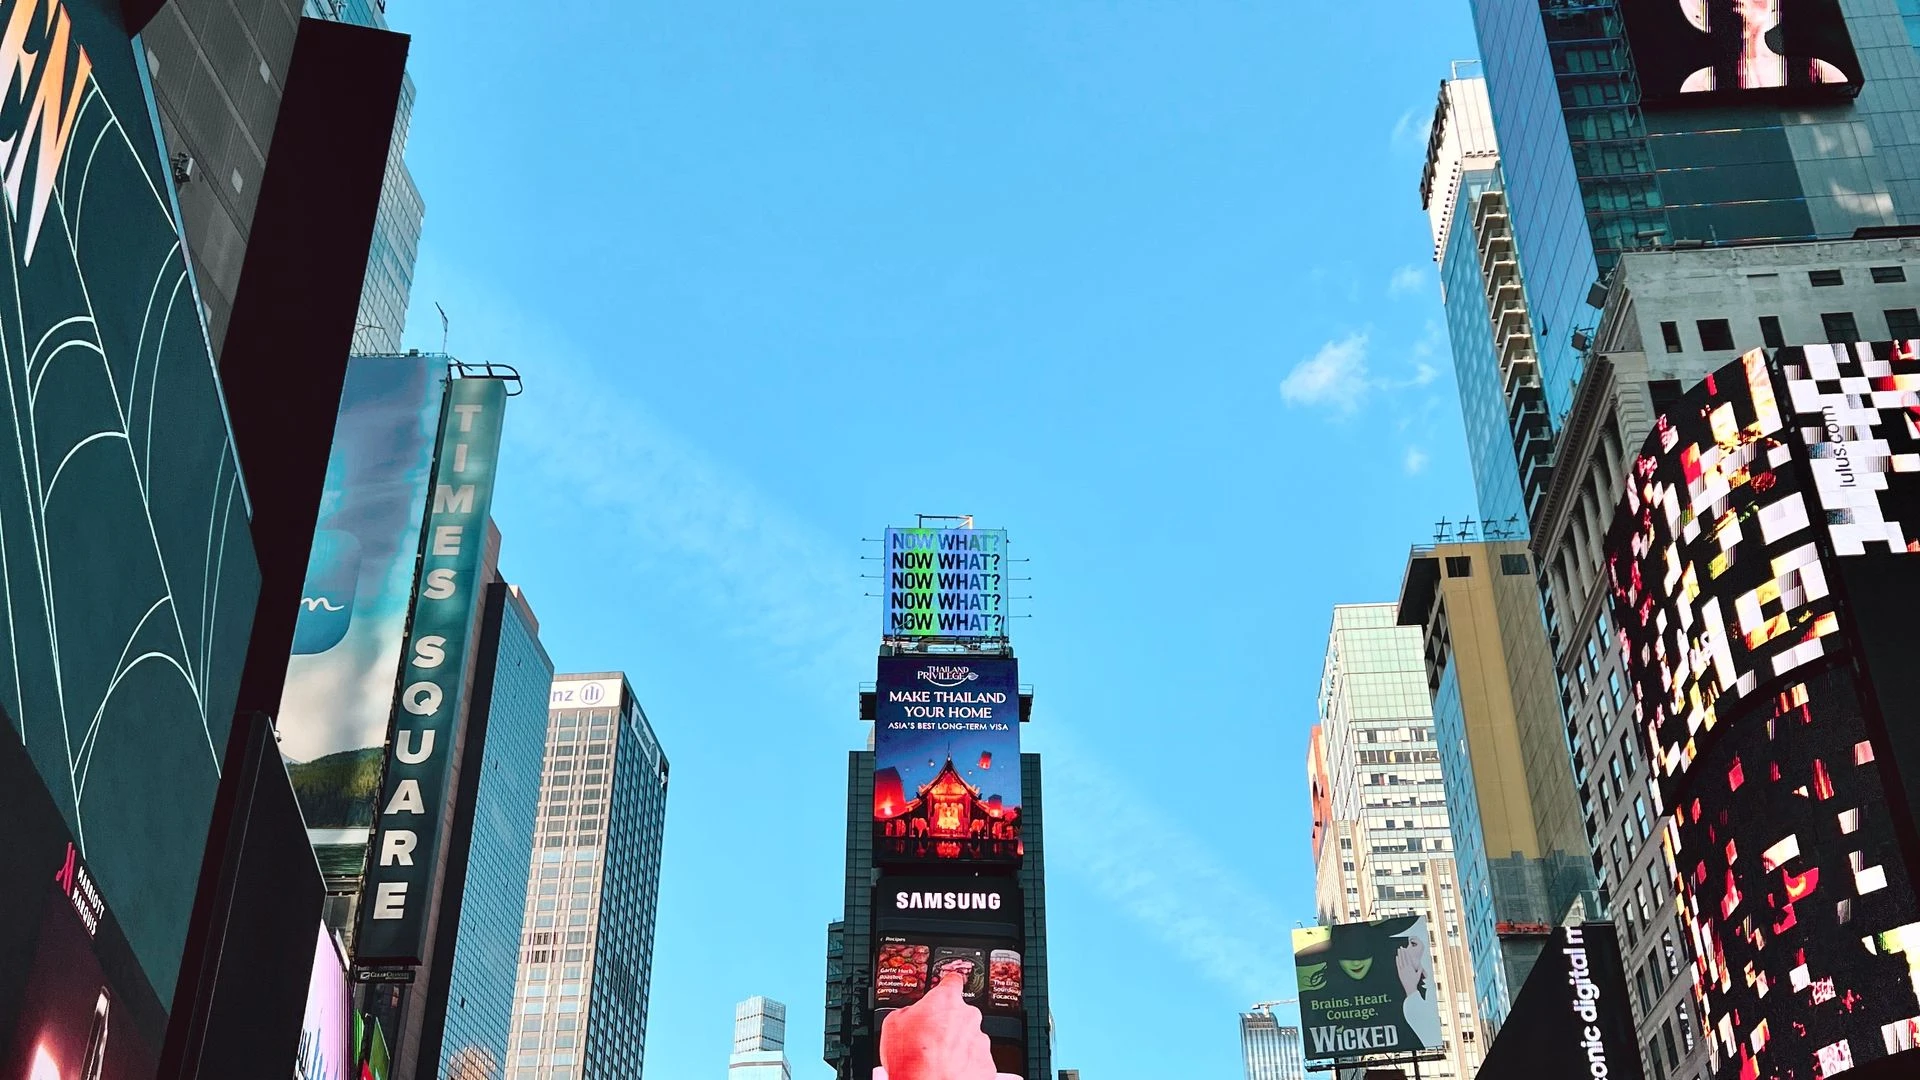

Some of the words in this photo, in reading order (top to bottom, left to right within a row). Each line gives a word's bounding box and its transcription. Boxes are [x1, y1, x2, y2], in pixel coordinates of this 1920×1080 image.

[1821, 405, 1857, 488] lulus.com
[423, 404, 483, 600] TIMES
[892, 533, 934, 550] NOW
[938, 534, 1000, 552] WHAT?
[892, 552, 934, 569] NOW
[938, 553, 1000, 570] WHAT?
[892, 572, 934, 589] NOW
[938, 573, 1000, 590] WHAT?
[891, 592, 934, 609] NOW
[938, 593, 1001, 611] WHAT?
[891, 612, 934, 630] NOW
[938, 613, 1001, 631] WHAT?
[917, 671, 967, 680] PRIVILEGE
[927, 665, 970, 674] THAILAND
[889, 691, 931, 703] MAKE
[934, 692, 1006, 704] THAILAND
[904, 706, 945, 718] YOUR
[949, 707, 992, 719] HOME
[888, 722, 916, 730] ASIA'S
[918, 722, 935, 730] BEST
[938, 723, 987, 731] LONG-TERM
[373, 635, 446, 919] SQUARE
[77, 866, 105, 920] MARRIOTT
[896, 891, 1001, 910] SAMSUNG
[72, 886, 97, 936] MARQUIS
[1562, 948, 1600, 1023] digital
[1311, 998, 1353, 1010] Brains.
[1354, 993, 1392, 1006] Heart.
[1326, 1007, 1379, 1020] Courage.
[1580, 1025, 1609, 1080] onic
